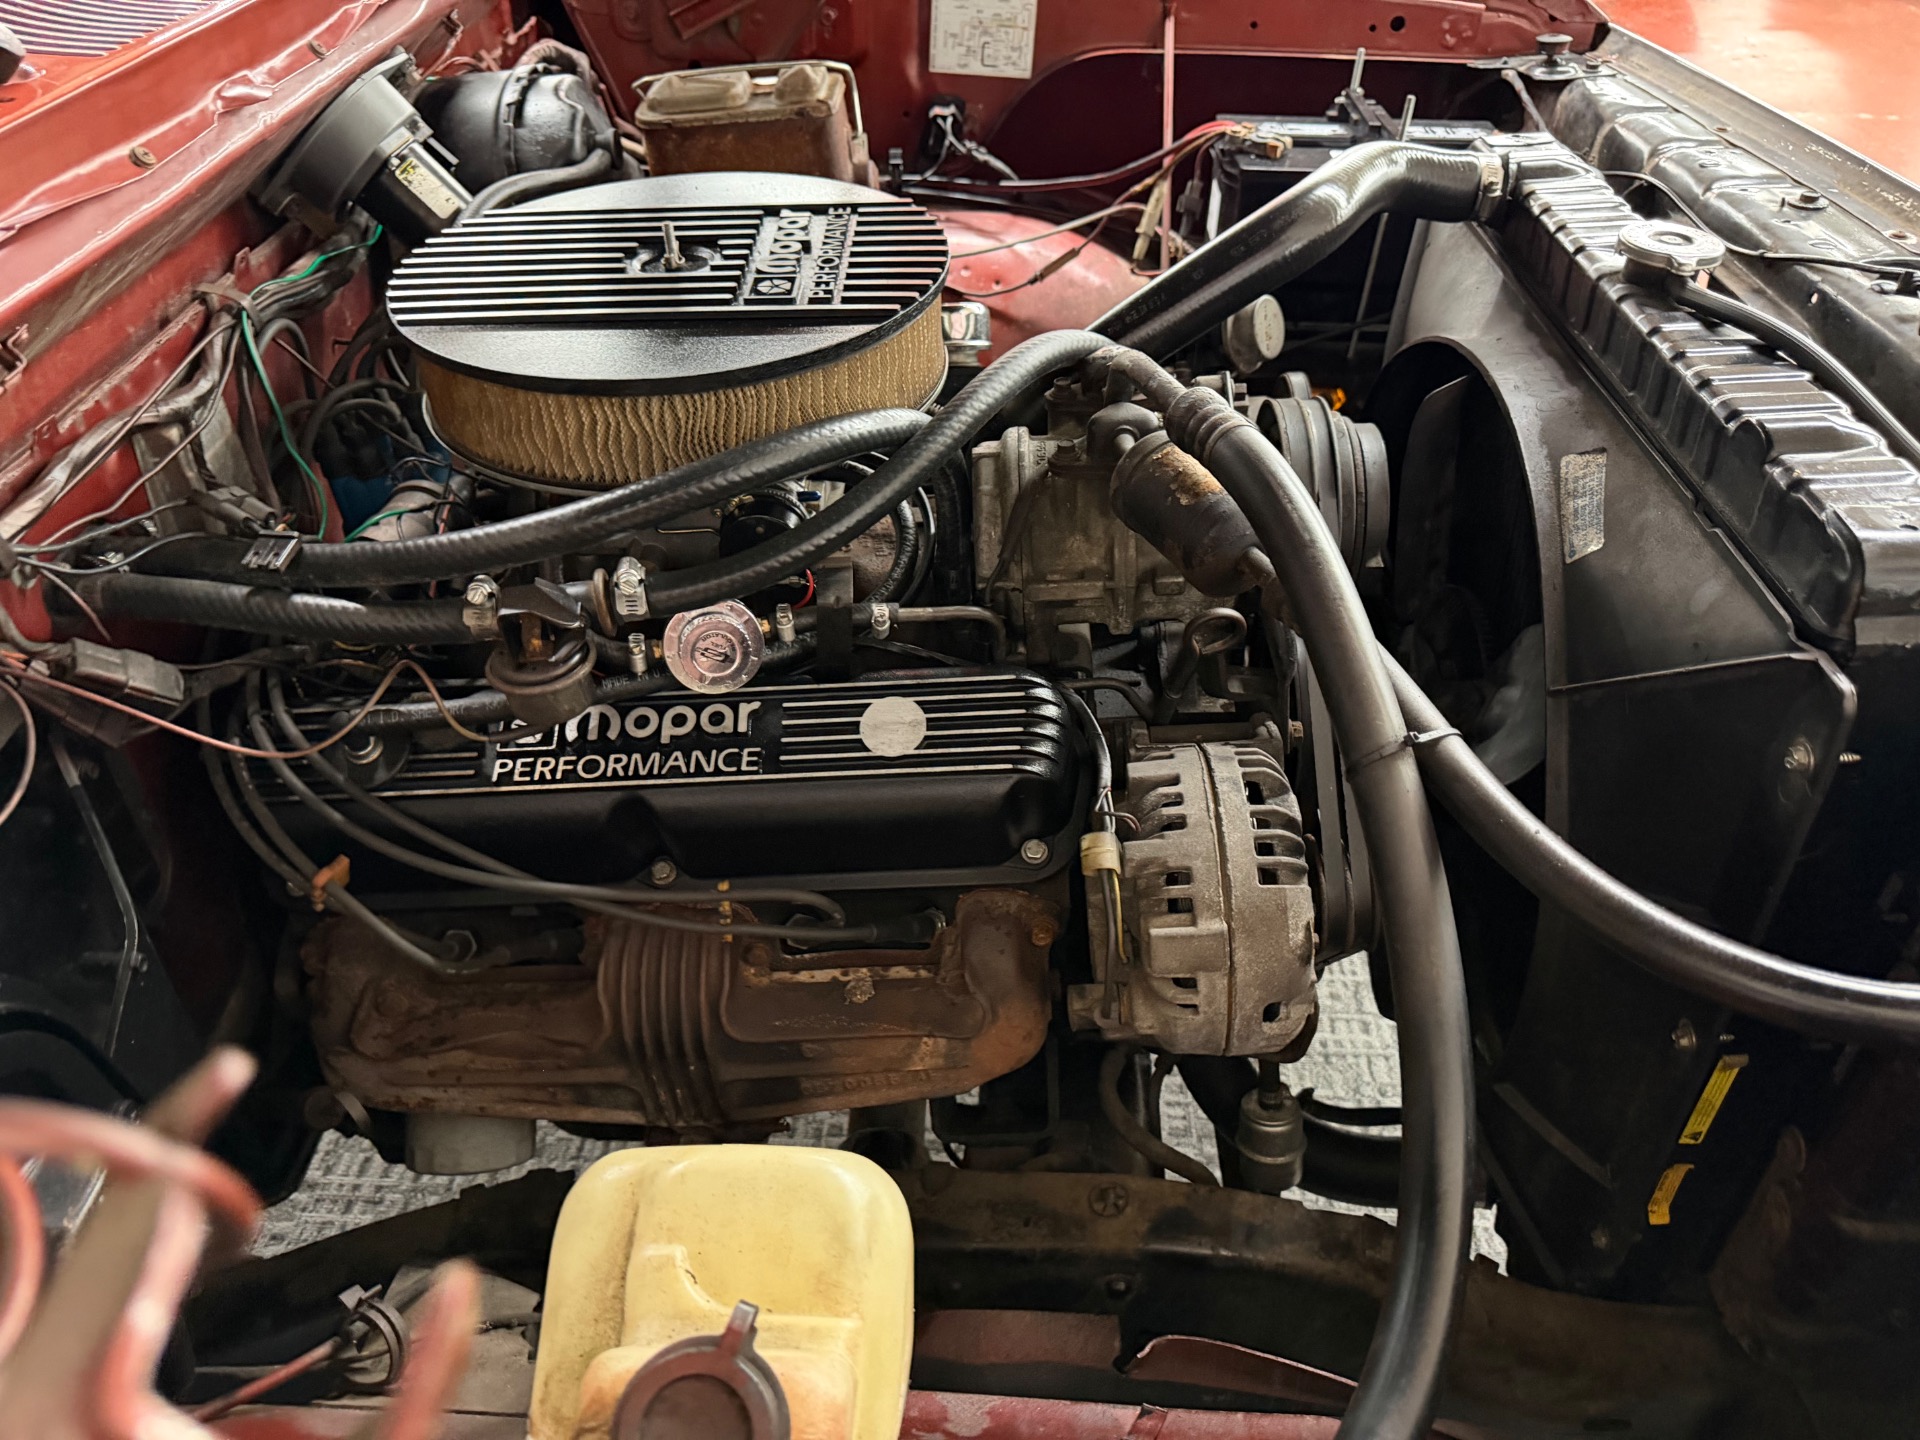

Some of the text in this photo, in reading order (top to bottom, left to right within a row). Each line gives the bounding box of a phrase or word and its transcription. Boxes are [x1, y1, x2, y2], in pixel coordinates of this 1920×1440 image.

[810, 206, 852, 298] PERFORMANCE
[601, 675, 630, 689] MADE
[491, 748, 762, 783] PERFORMANCE
